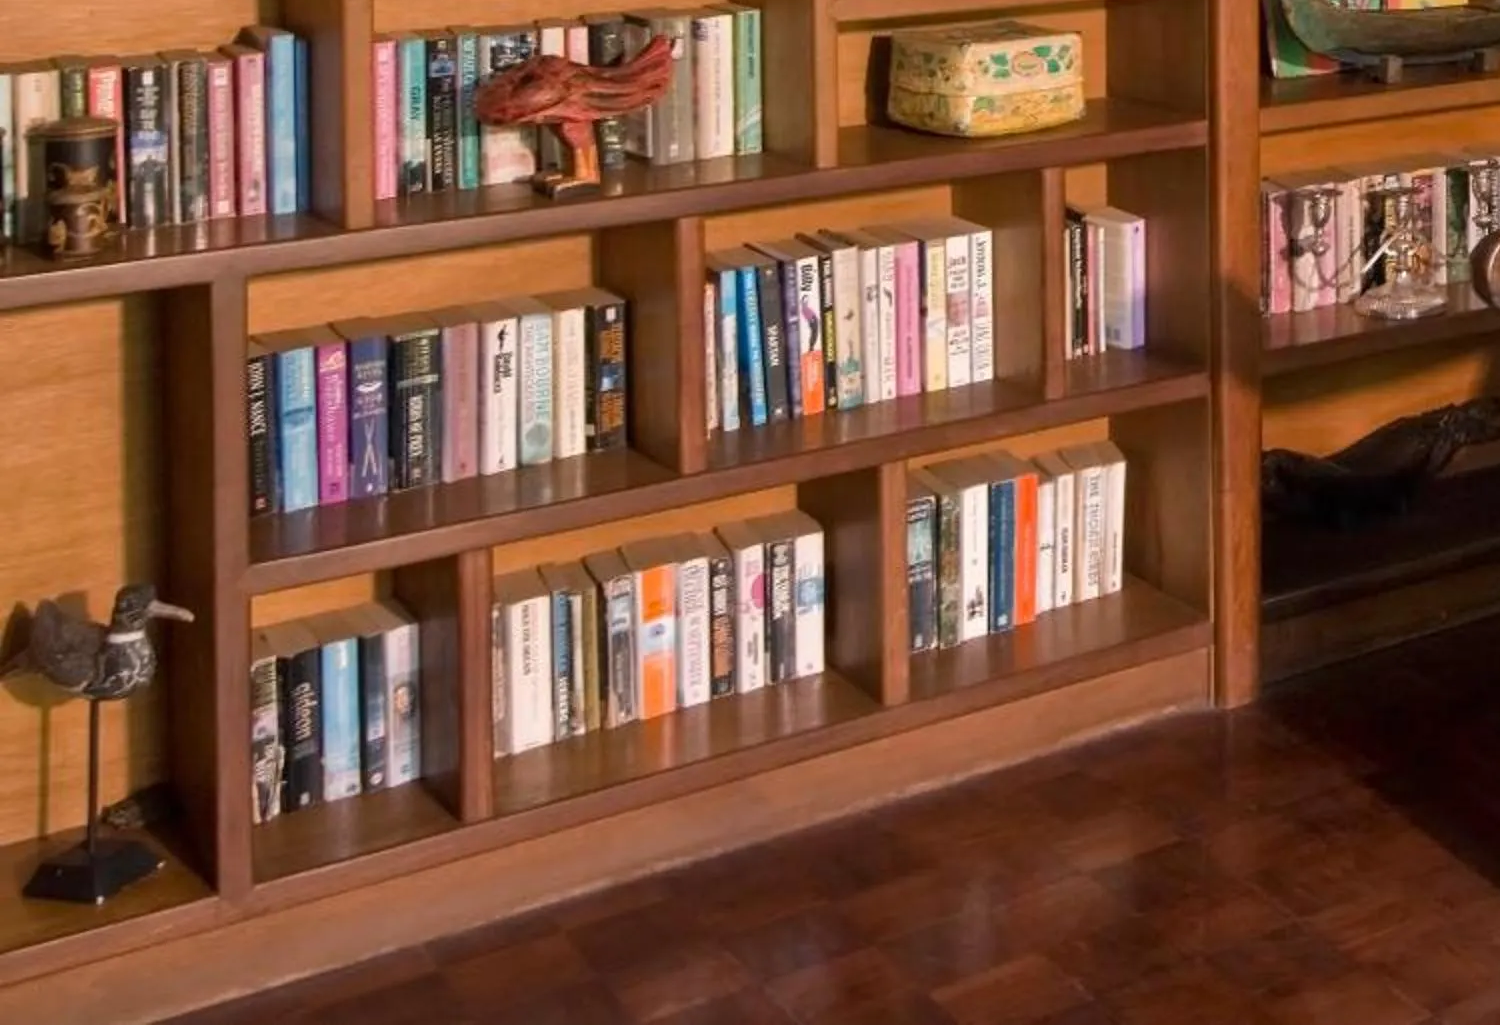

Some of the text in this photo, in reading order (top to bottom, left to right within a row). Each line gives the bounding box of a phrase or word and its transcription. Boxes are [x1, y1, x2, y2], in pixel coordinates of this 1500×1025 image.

[801, 264, 816, 292] Billy
[767, 324, 780, 367] SPARTAN
[535, 357, 549, 422] BOURNE
[250, 400, 266, 438] NANCE
